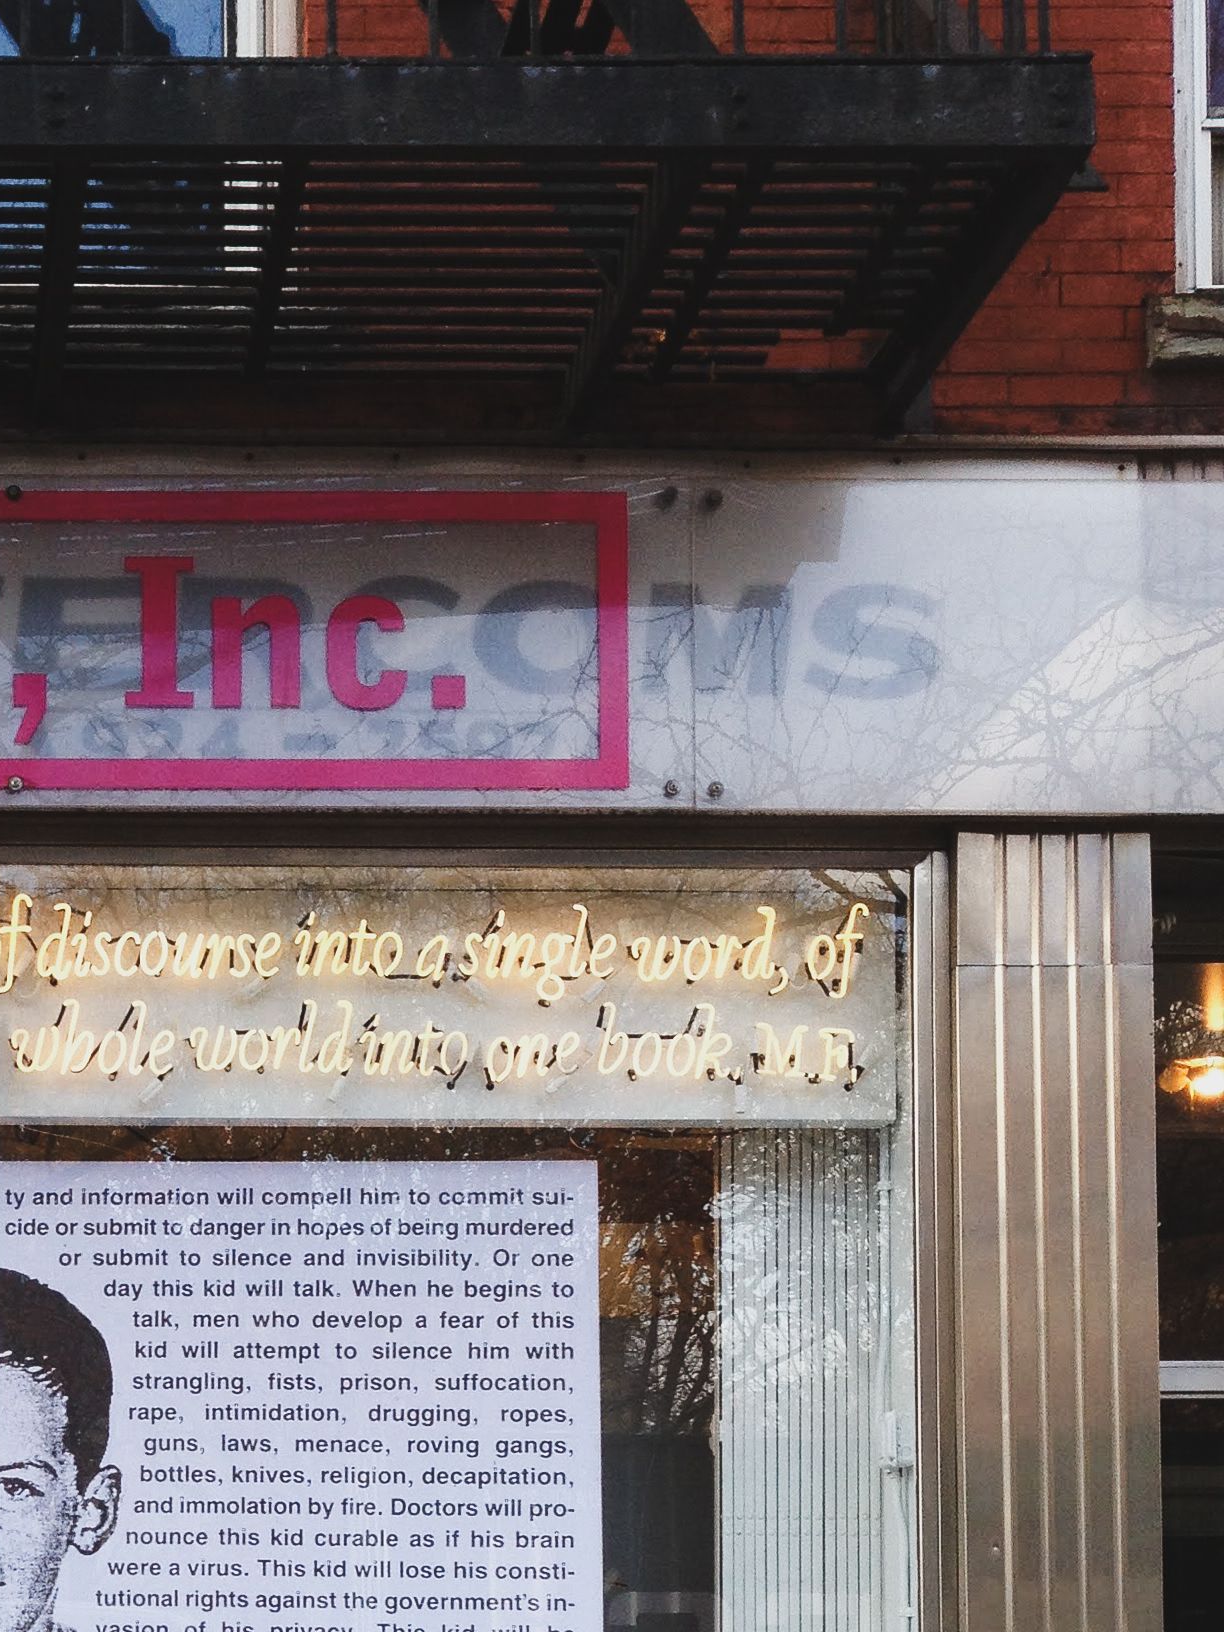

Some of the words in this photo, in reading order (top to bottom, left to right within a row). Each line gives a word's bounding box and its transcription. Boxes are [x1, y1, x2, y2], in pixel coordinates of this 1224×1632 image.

[124, 556, 466, 710] Inc.
[36, 902, 283, 981] discourse
[294, 911, 404, 978] into
[415, 932, 449, 984] a
[460, 904, 618, 1001] single
[630, 905, 789, 996] word,
[805, 902, 870, 999] of
[10, 998, 177, 1076] whole
[187, 999, 354, 1075] world
[358, 1013, 468, 1077] into
[485, 1029, 581, 1084] one
[131, 1309, 180, 1332] talk,
[192, 1313, 240, 1329] men
[251, 1309, 300, 1329] who
[311, 1310, 403, 1334] develop
[414, 1314, 428, 1329] a
[439, 1310, 485, 1329] fear
[495, 1310, 520, 1329] of
[530, 1310, 575, 1330] this
[132, 1371, 252, 1395] strangling,
[267, 1372, 323, 1395] fists,
[339, 1372, 419, 1396] prison,
[434, 1372, 574, 1395] suffocation,
[139, 1464, 223, 1487] bottles,
[231, 1464, 312, 1488] knives,
[320, 1465, 414, 1489] religion,
[421, 1466, 574, 1490] decapitation,
